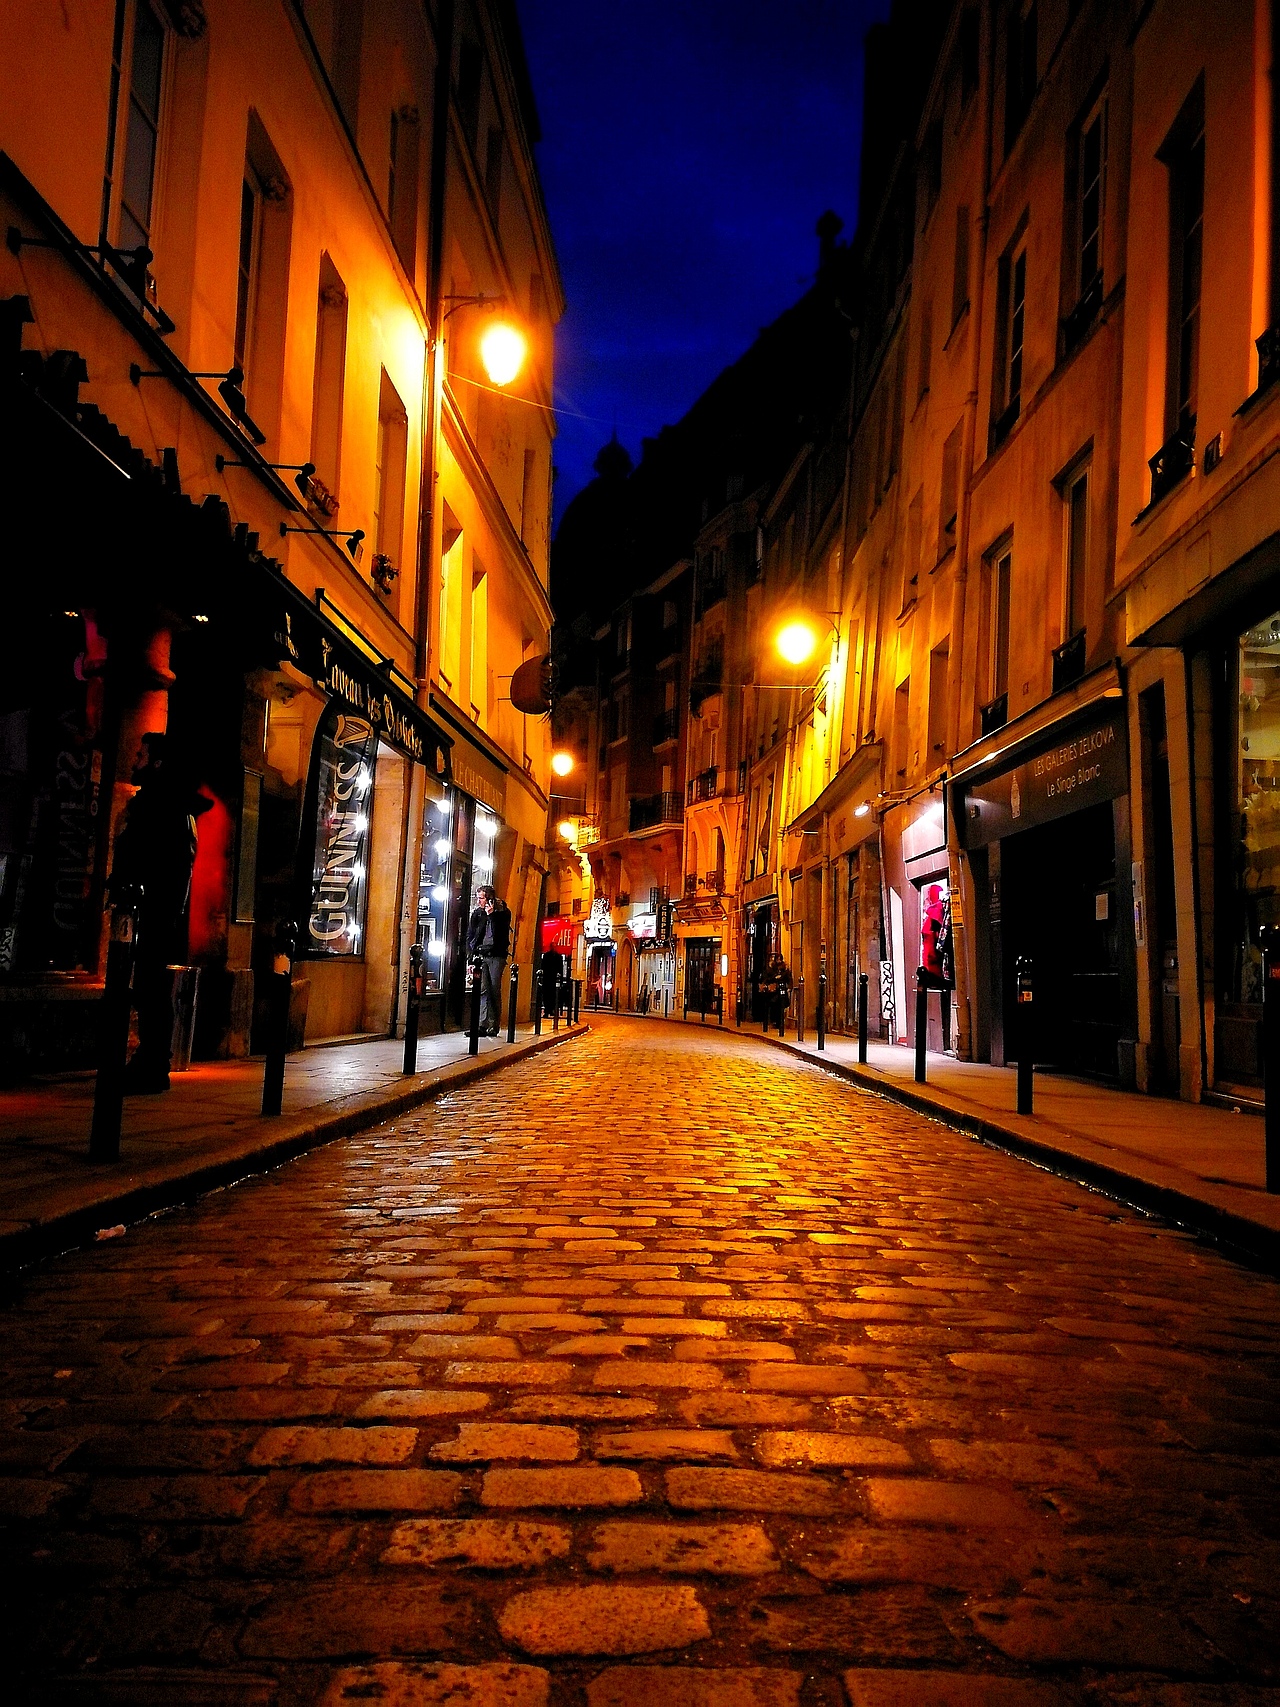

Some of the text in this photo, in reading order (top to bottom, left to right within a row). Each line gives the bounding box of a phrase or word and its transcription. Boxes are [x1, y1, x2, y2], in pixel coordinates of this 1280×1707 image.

[1034, 725, 1115, 777] LES GALERIES ZELKOVA
[1046, 763, 1101, 797] Le Singe Blanc
[309, 760, 368, 941] GUINNESS
